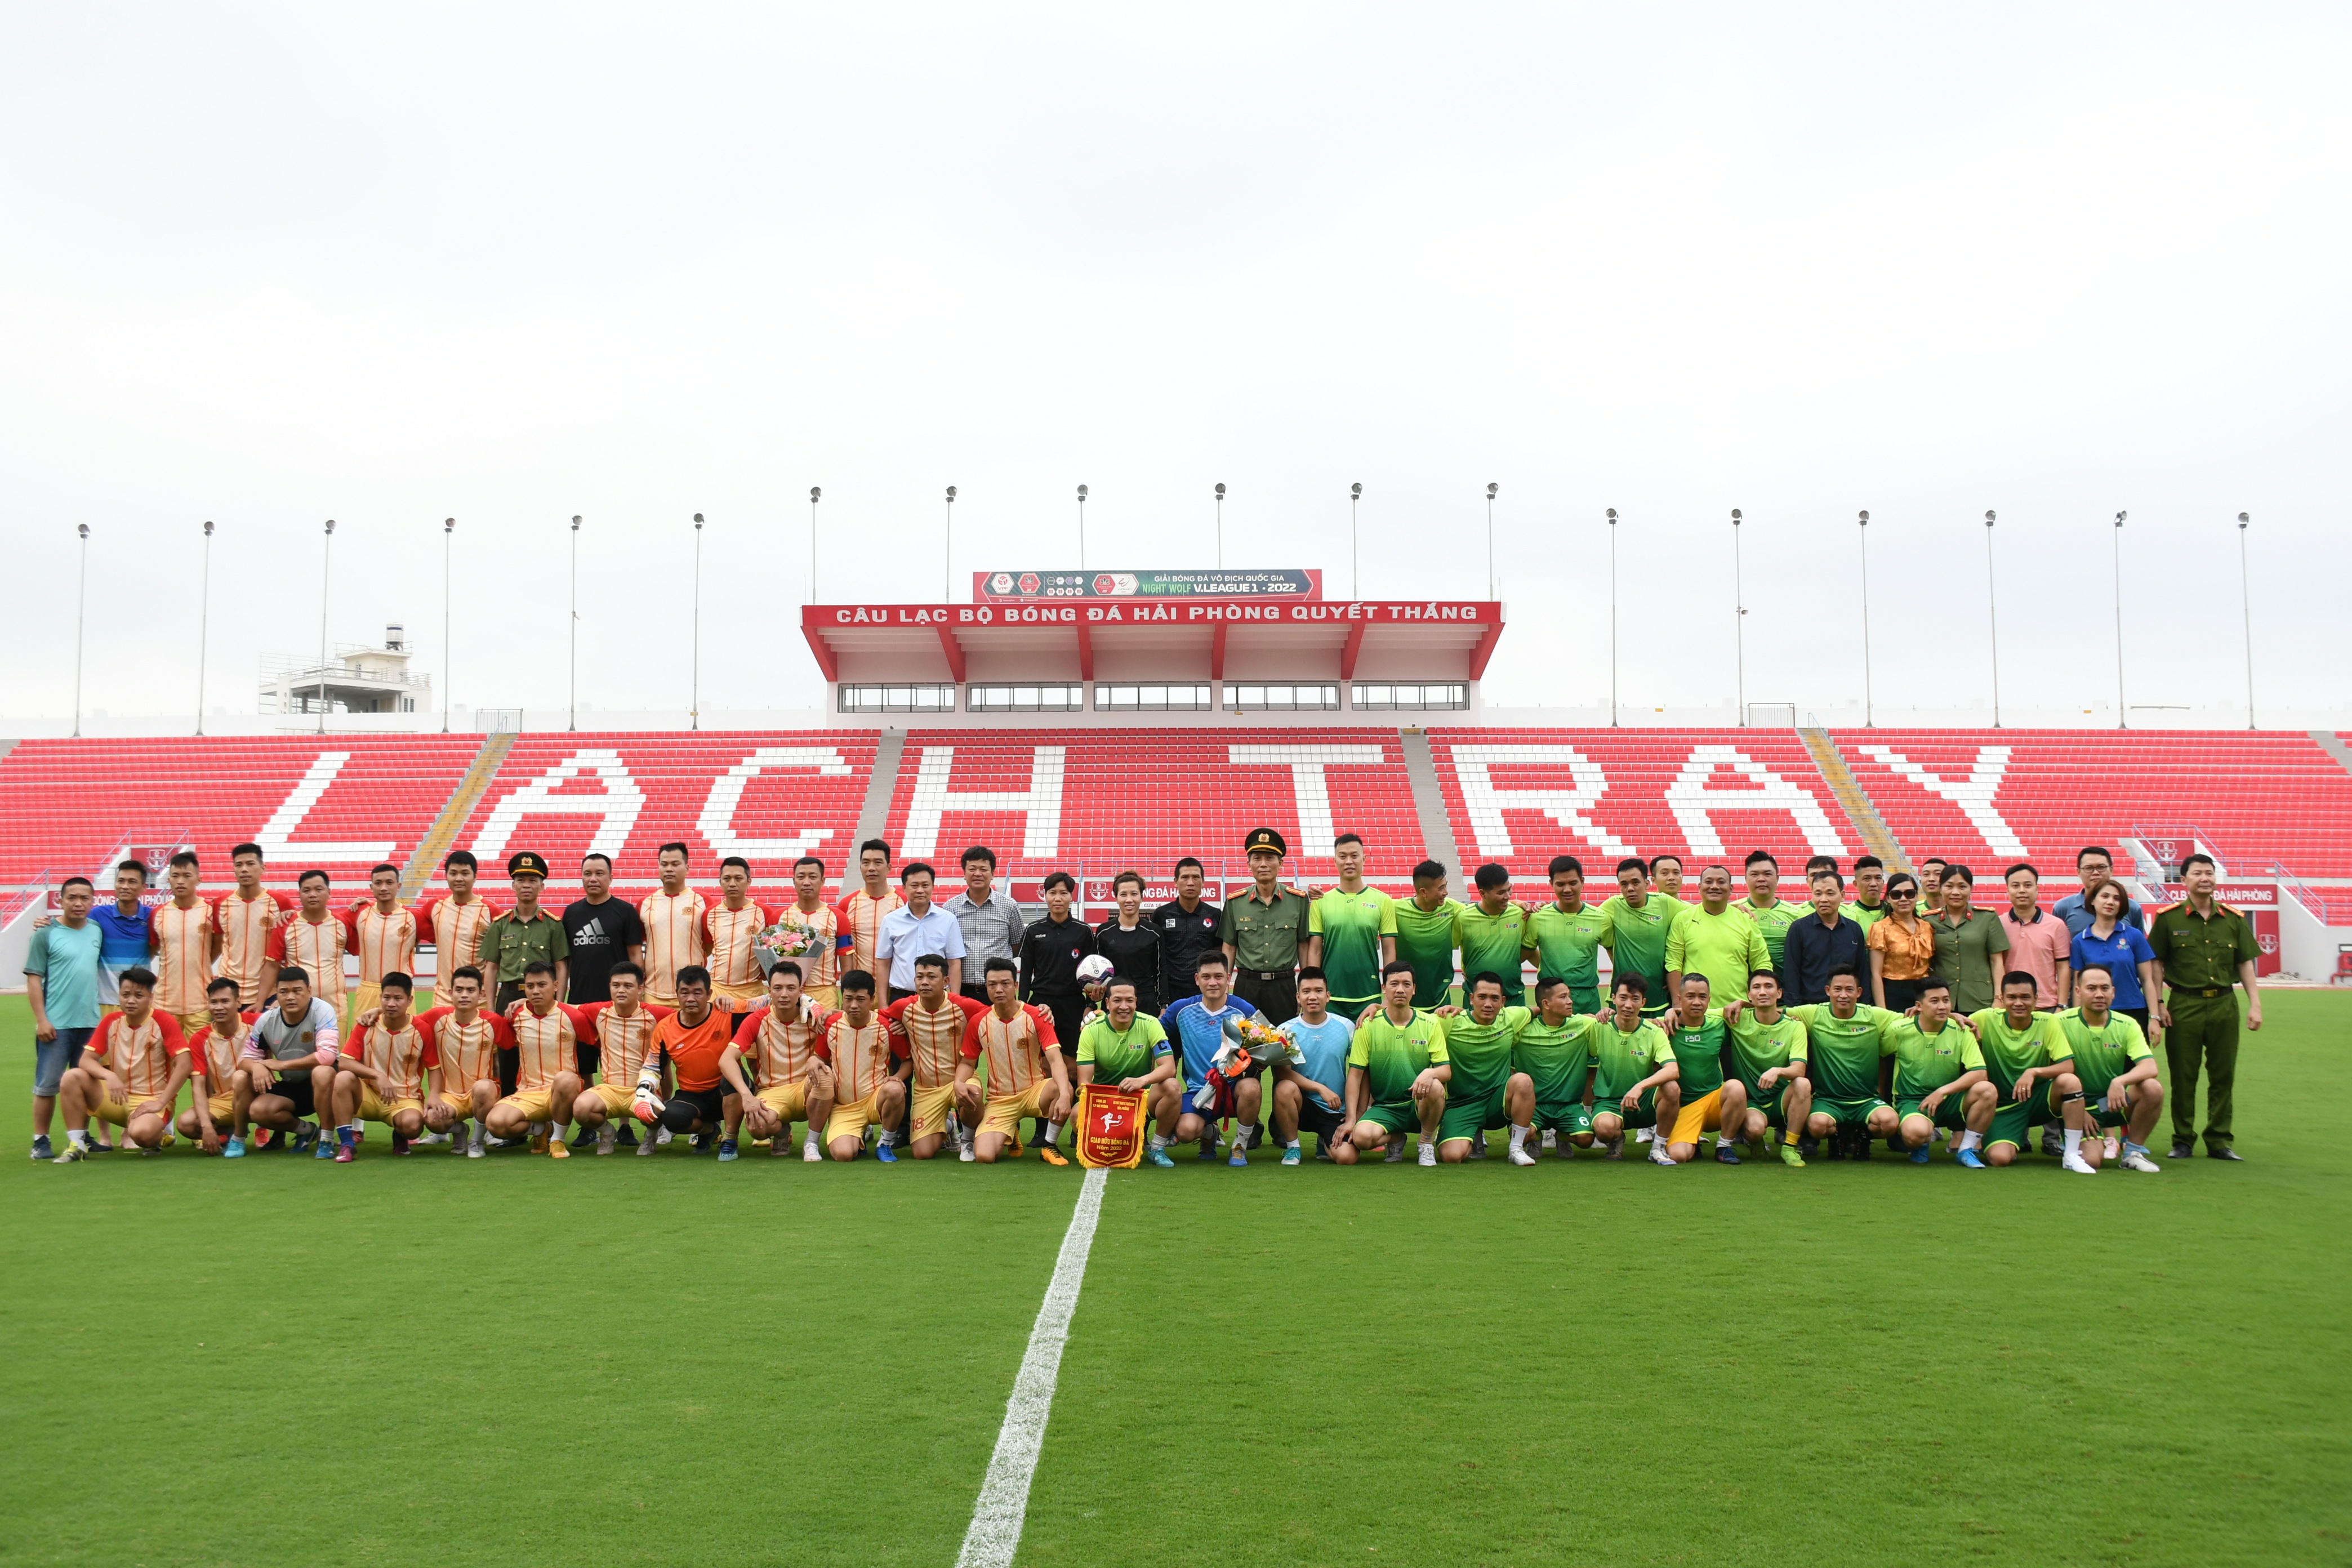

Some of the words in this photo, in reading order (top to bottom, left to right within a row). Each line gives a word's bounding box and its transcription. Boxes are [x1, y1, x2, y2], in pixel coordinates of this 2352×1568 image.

[1154, 573, 1170, 582] GIẢI
[1245, 573, 1268, 582] QUỐC
[1142, 583, 1166, 595] NIGHT
[1169, 583, 1191, 595] WOLF
[1193, 583, 1250, 593] V.LEAGUE
[1267, 583, 1297, 592] 2022
[836, 607, 888, 623] CÂU
[899, 609, 947, 625] LẠC
[960, 607, 993, 625] BỘ
[1005, 606, 1076, 621] BÓNG
[1086, 605, 1122, 621] ĐÁ
[1134, 604, 1177, 620] HẢI
[1190, 604, 1280, 620] PHÒNG
[1291, 602, 1378, 620] QUYẾT
[1388, 603, 1477, 620] THẮNG
[1156, 885, 1169, 898] ĐÁ
[2242, 888, 2267, 901] PHÒNG
[573, 934, 611, 946] adidas
[1157, 1040, 1168, 1050] C
[912, 1117, 924, 1132] 18
[1579, 1116, 1589, 1126] 6
